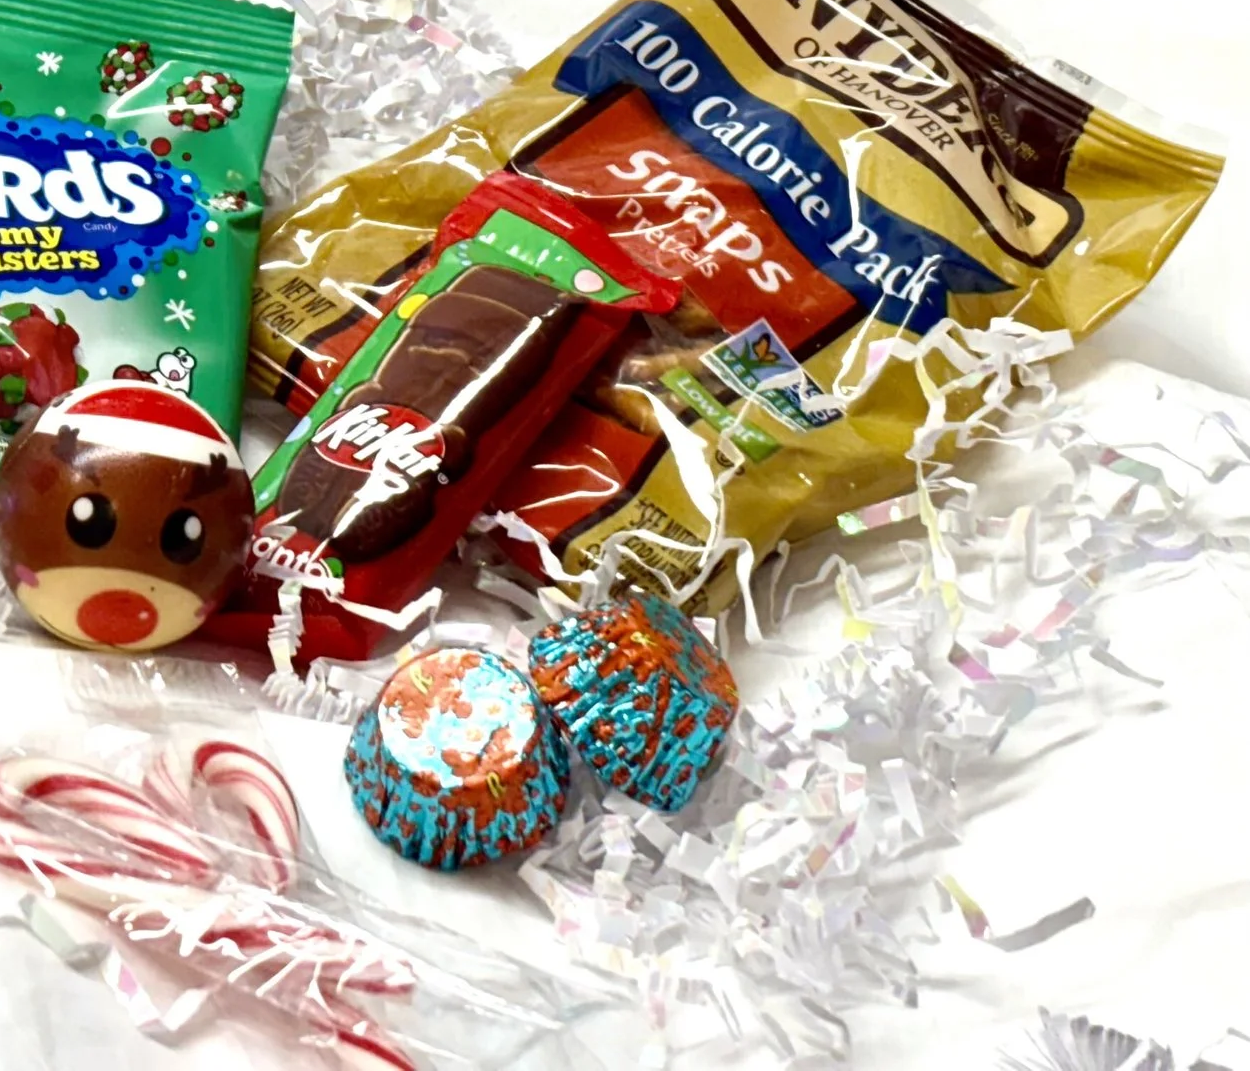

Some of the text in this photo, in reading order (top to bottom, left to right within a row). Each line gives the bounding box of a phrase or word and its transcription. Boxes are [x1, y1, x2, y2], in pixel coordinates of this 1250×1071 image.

[828, 66, 954, 151] HANOVER
[615, 19, 941, 305] 100 Calorie Pack
[83, 223, 117, 233] Candy
[606, 150, 794, 292] Snaps
[616, 197, 719, 278] Pretzels
[276, 276, 337, 318] NET WT
[721, 350, 811, 429] VERFIED
